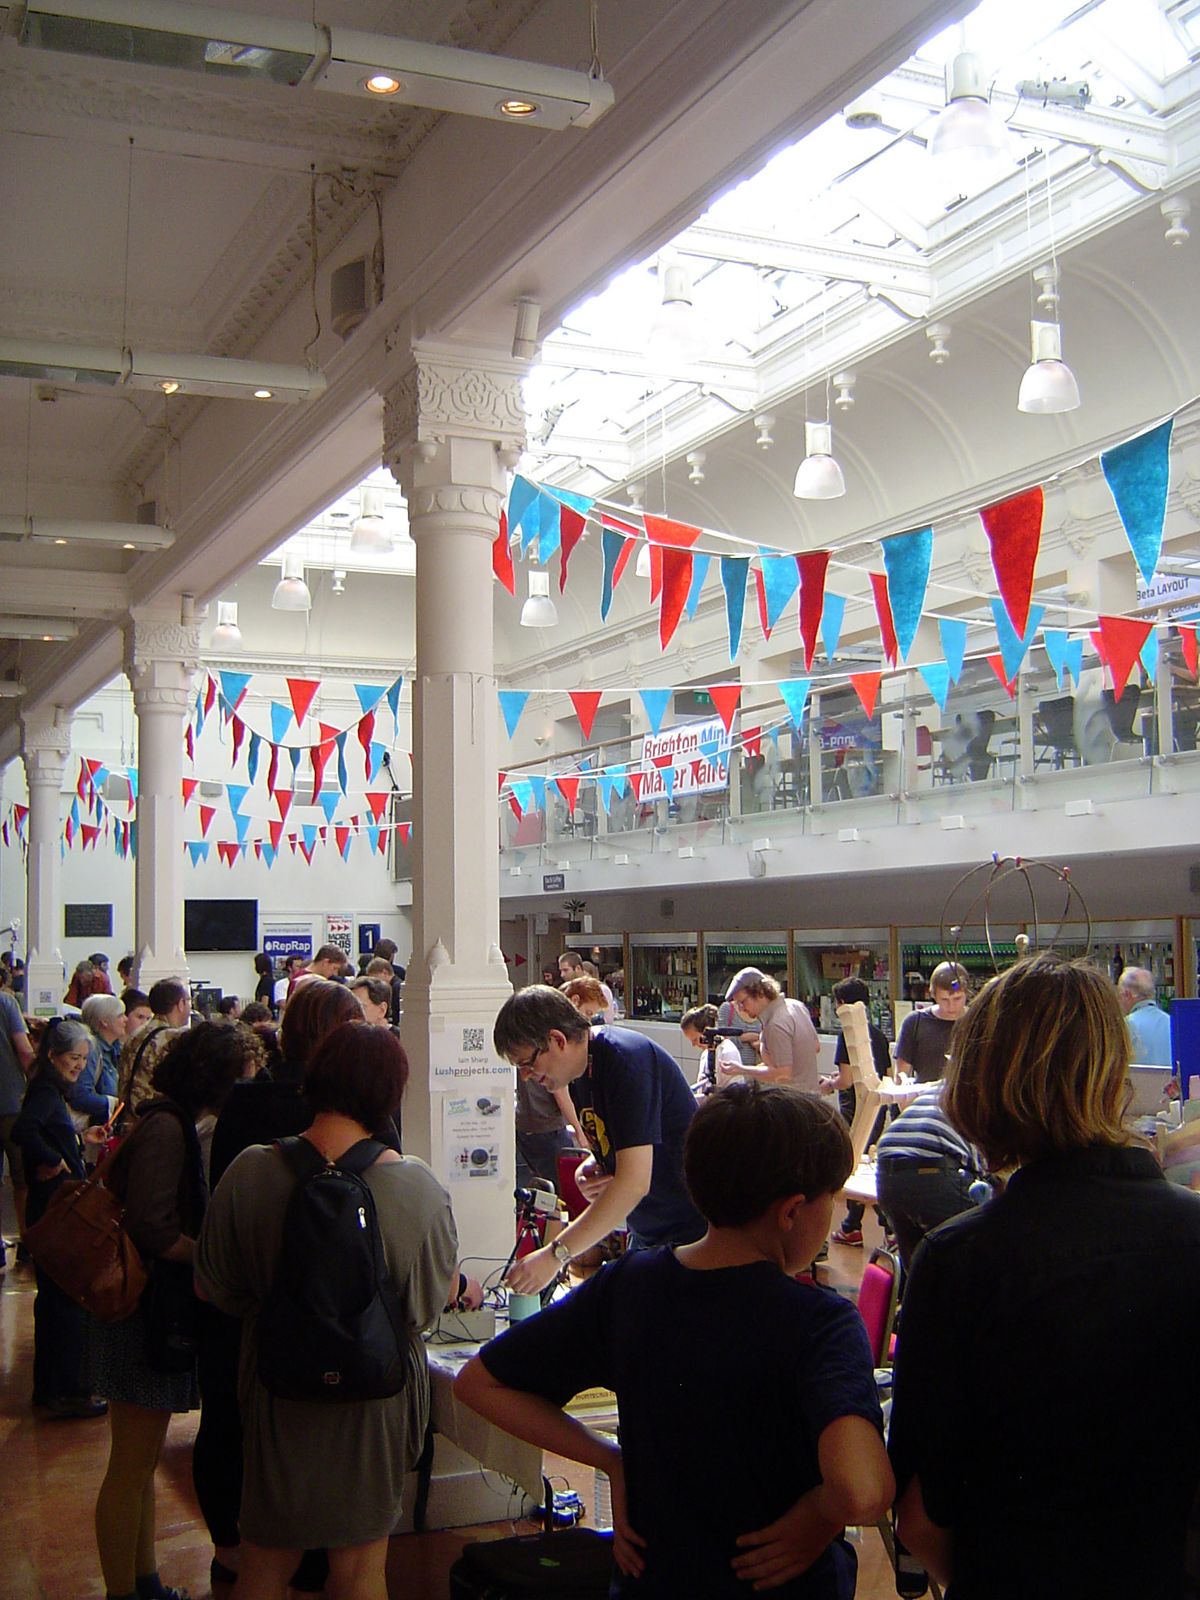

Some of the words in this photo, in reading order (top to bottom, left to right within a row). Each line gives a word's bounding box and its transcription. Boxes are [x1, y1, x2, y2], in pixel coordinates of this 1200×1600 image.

[1137, 589, 1155, 601] Beta
[1157, 578, 1189, 596] LAYOUT
[645, 733, 698, 759] Brighton
[642, 766, 687, 795] Maer
[328, 932, 351, 940] MORE
[365, 930, 373, 949] 1
[272, 940, 311, 953] RepRap
[434, 1066, 512, 1078] Lushprojects.com
